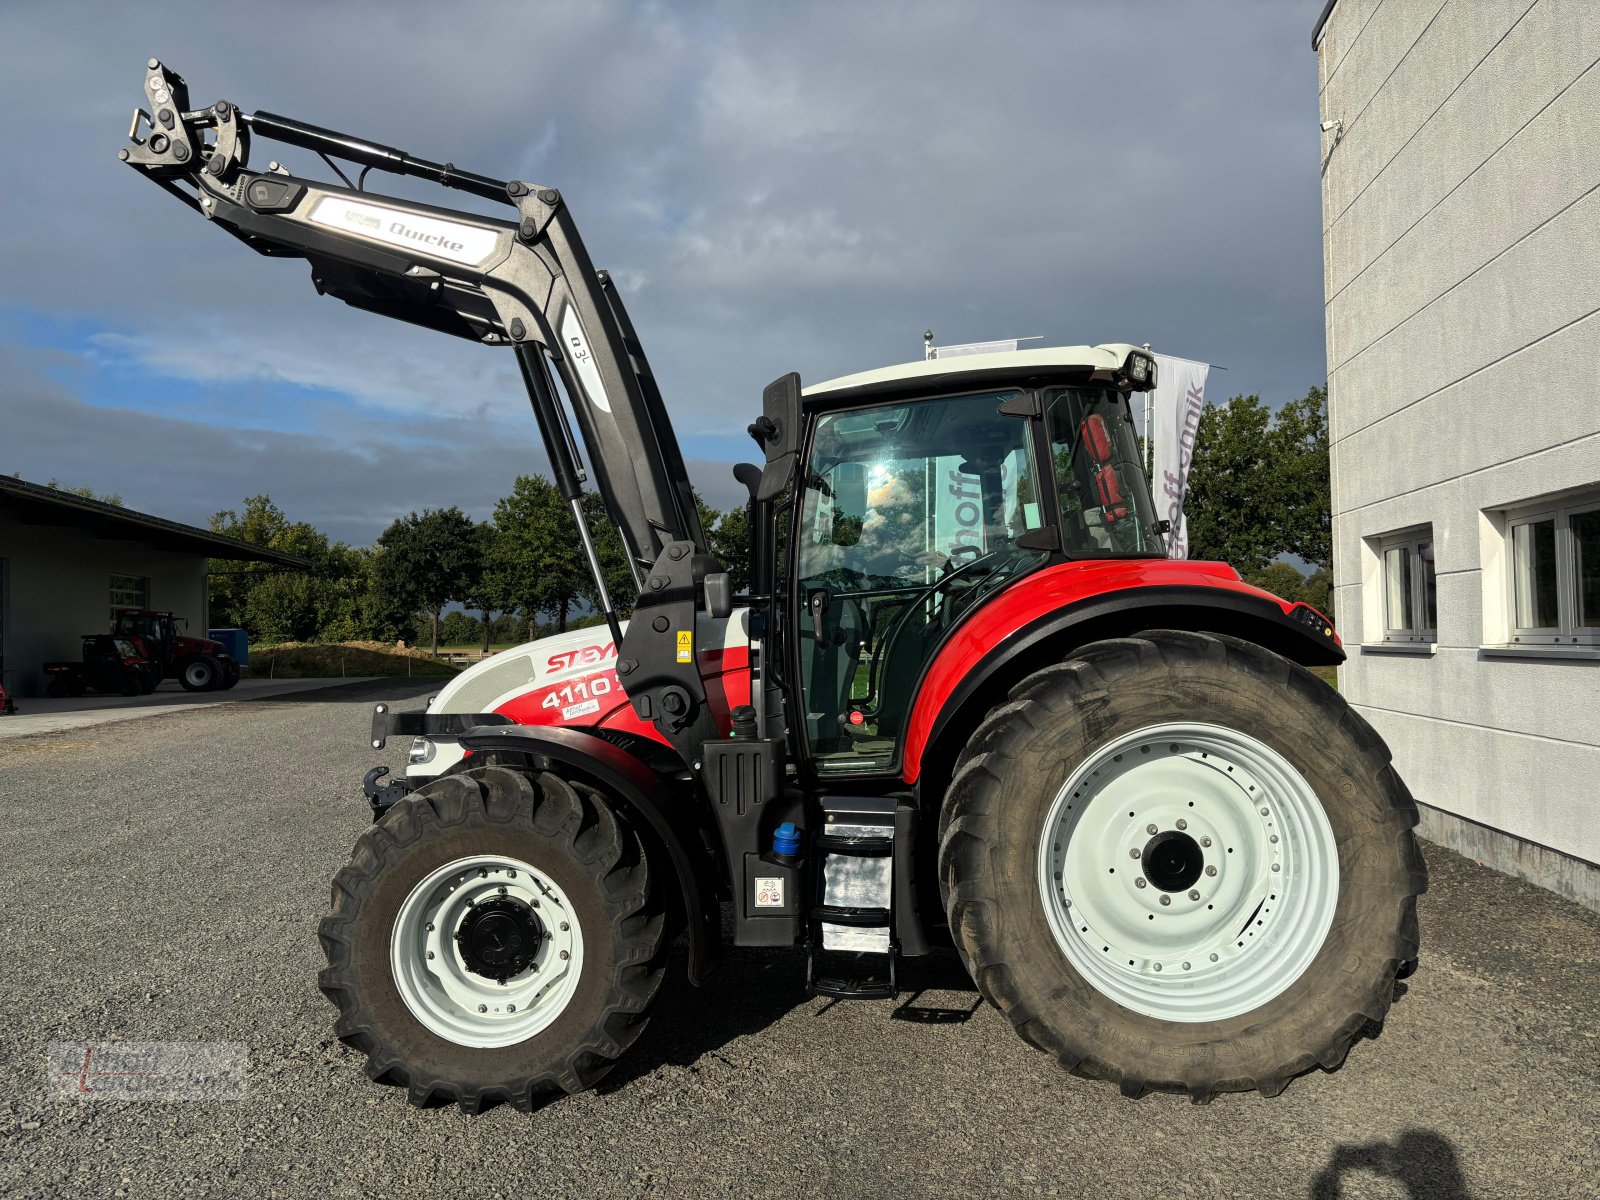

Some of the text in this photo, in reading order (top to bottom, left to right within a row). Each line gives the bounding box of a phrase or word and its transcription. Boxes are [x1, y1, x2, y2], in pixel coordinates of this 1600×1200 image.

[390, 222, 464, 252] Quicke
[948, 470, 980, 566] thoff
[541, 677, 611, 709] 4110
